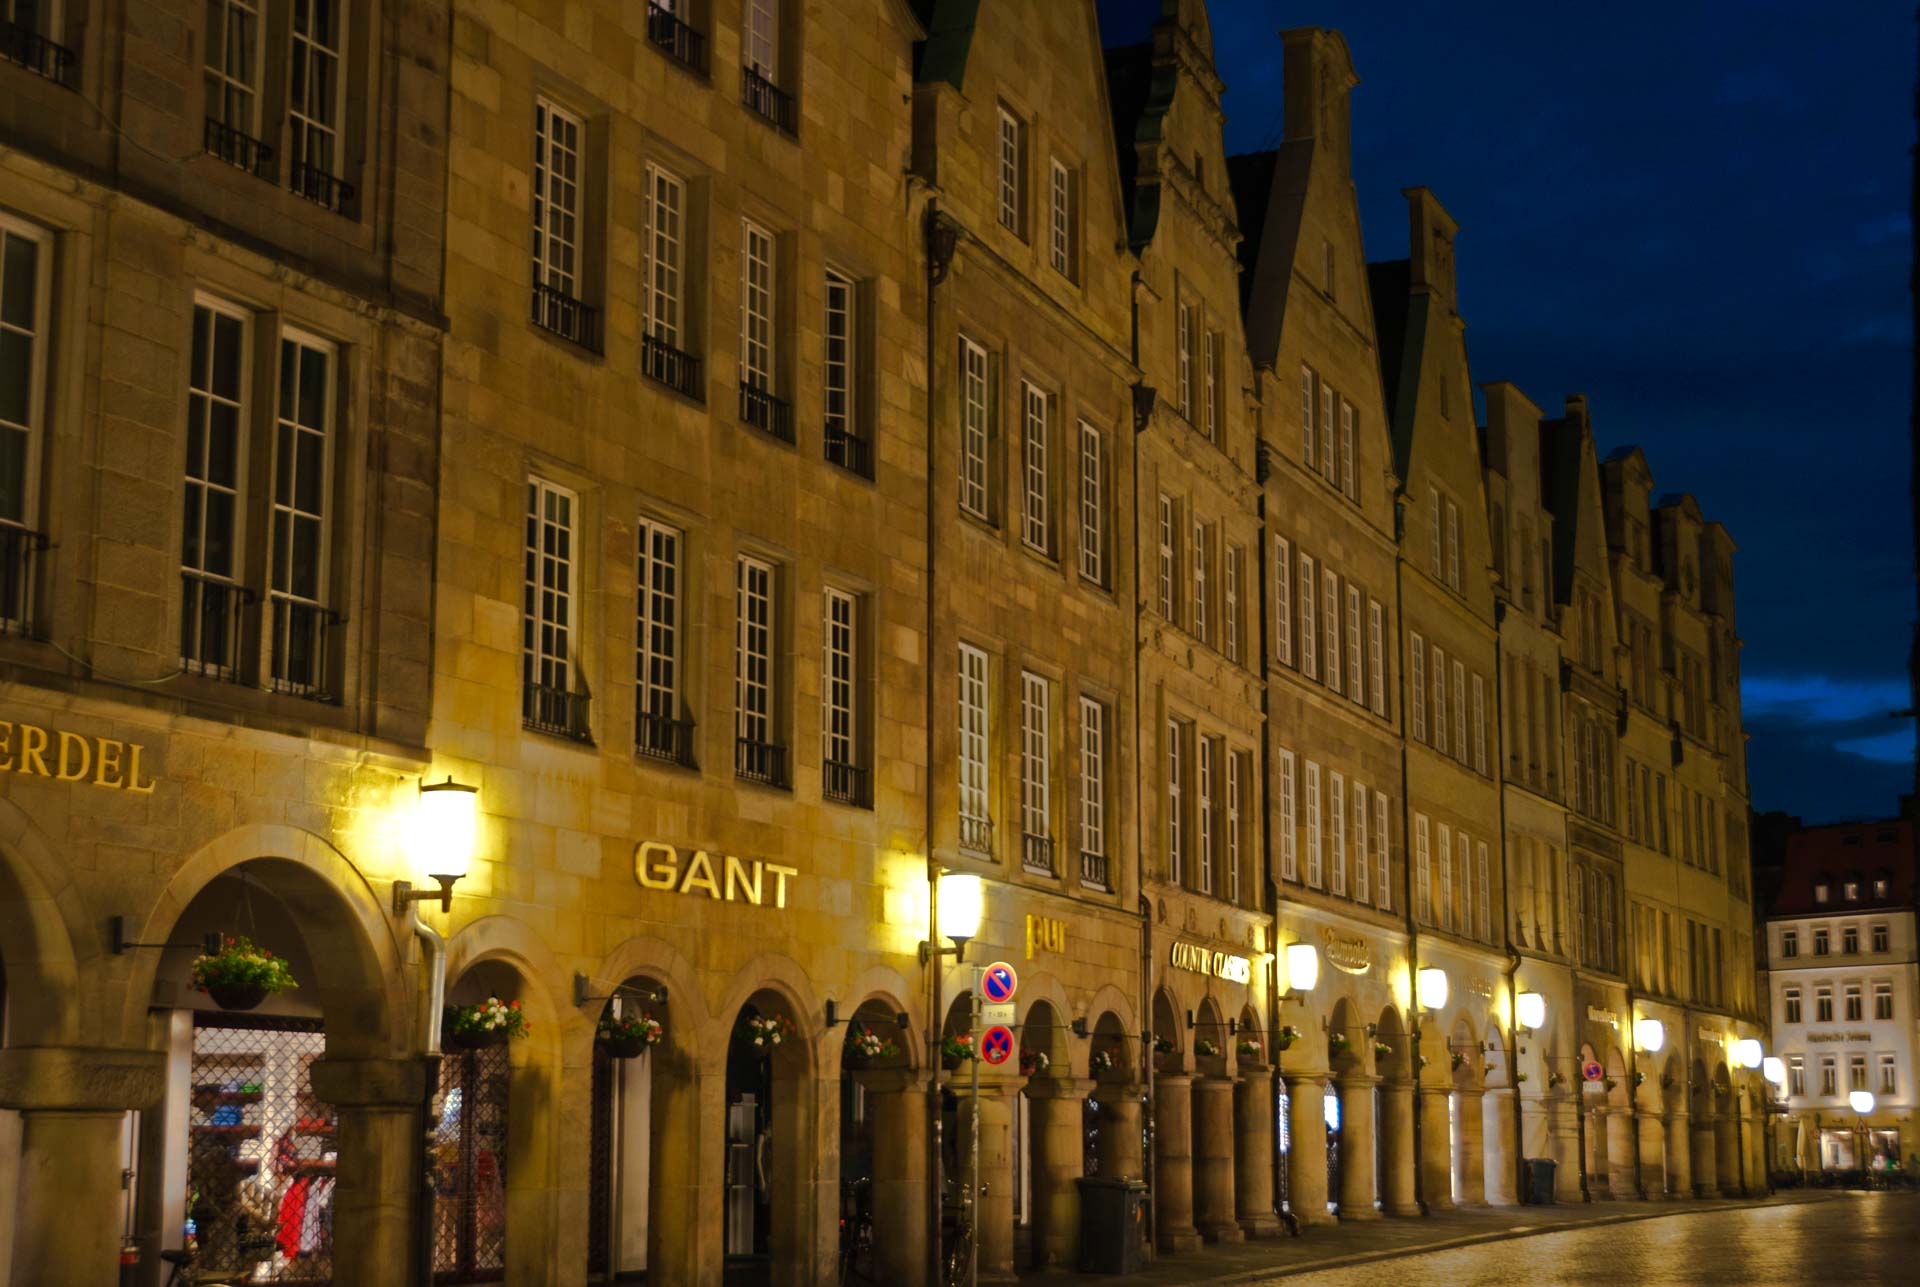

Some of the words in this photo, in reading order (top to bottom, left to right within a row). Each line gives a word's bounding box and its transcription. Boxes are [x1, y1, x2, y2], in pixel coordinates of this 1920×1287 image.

[635, 841, 798, 908] GANT
[1026, 914, 1069, 960] pur
[1171, 942, 1212, 975] COUNTRY
